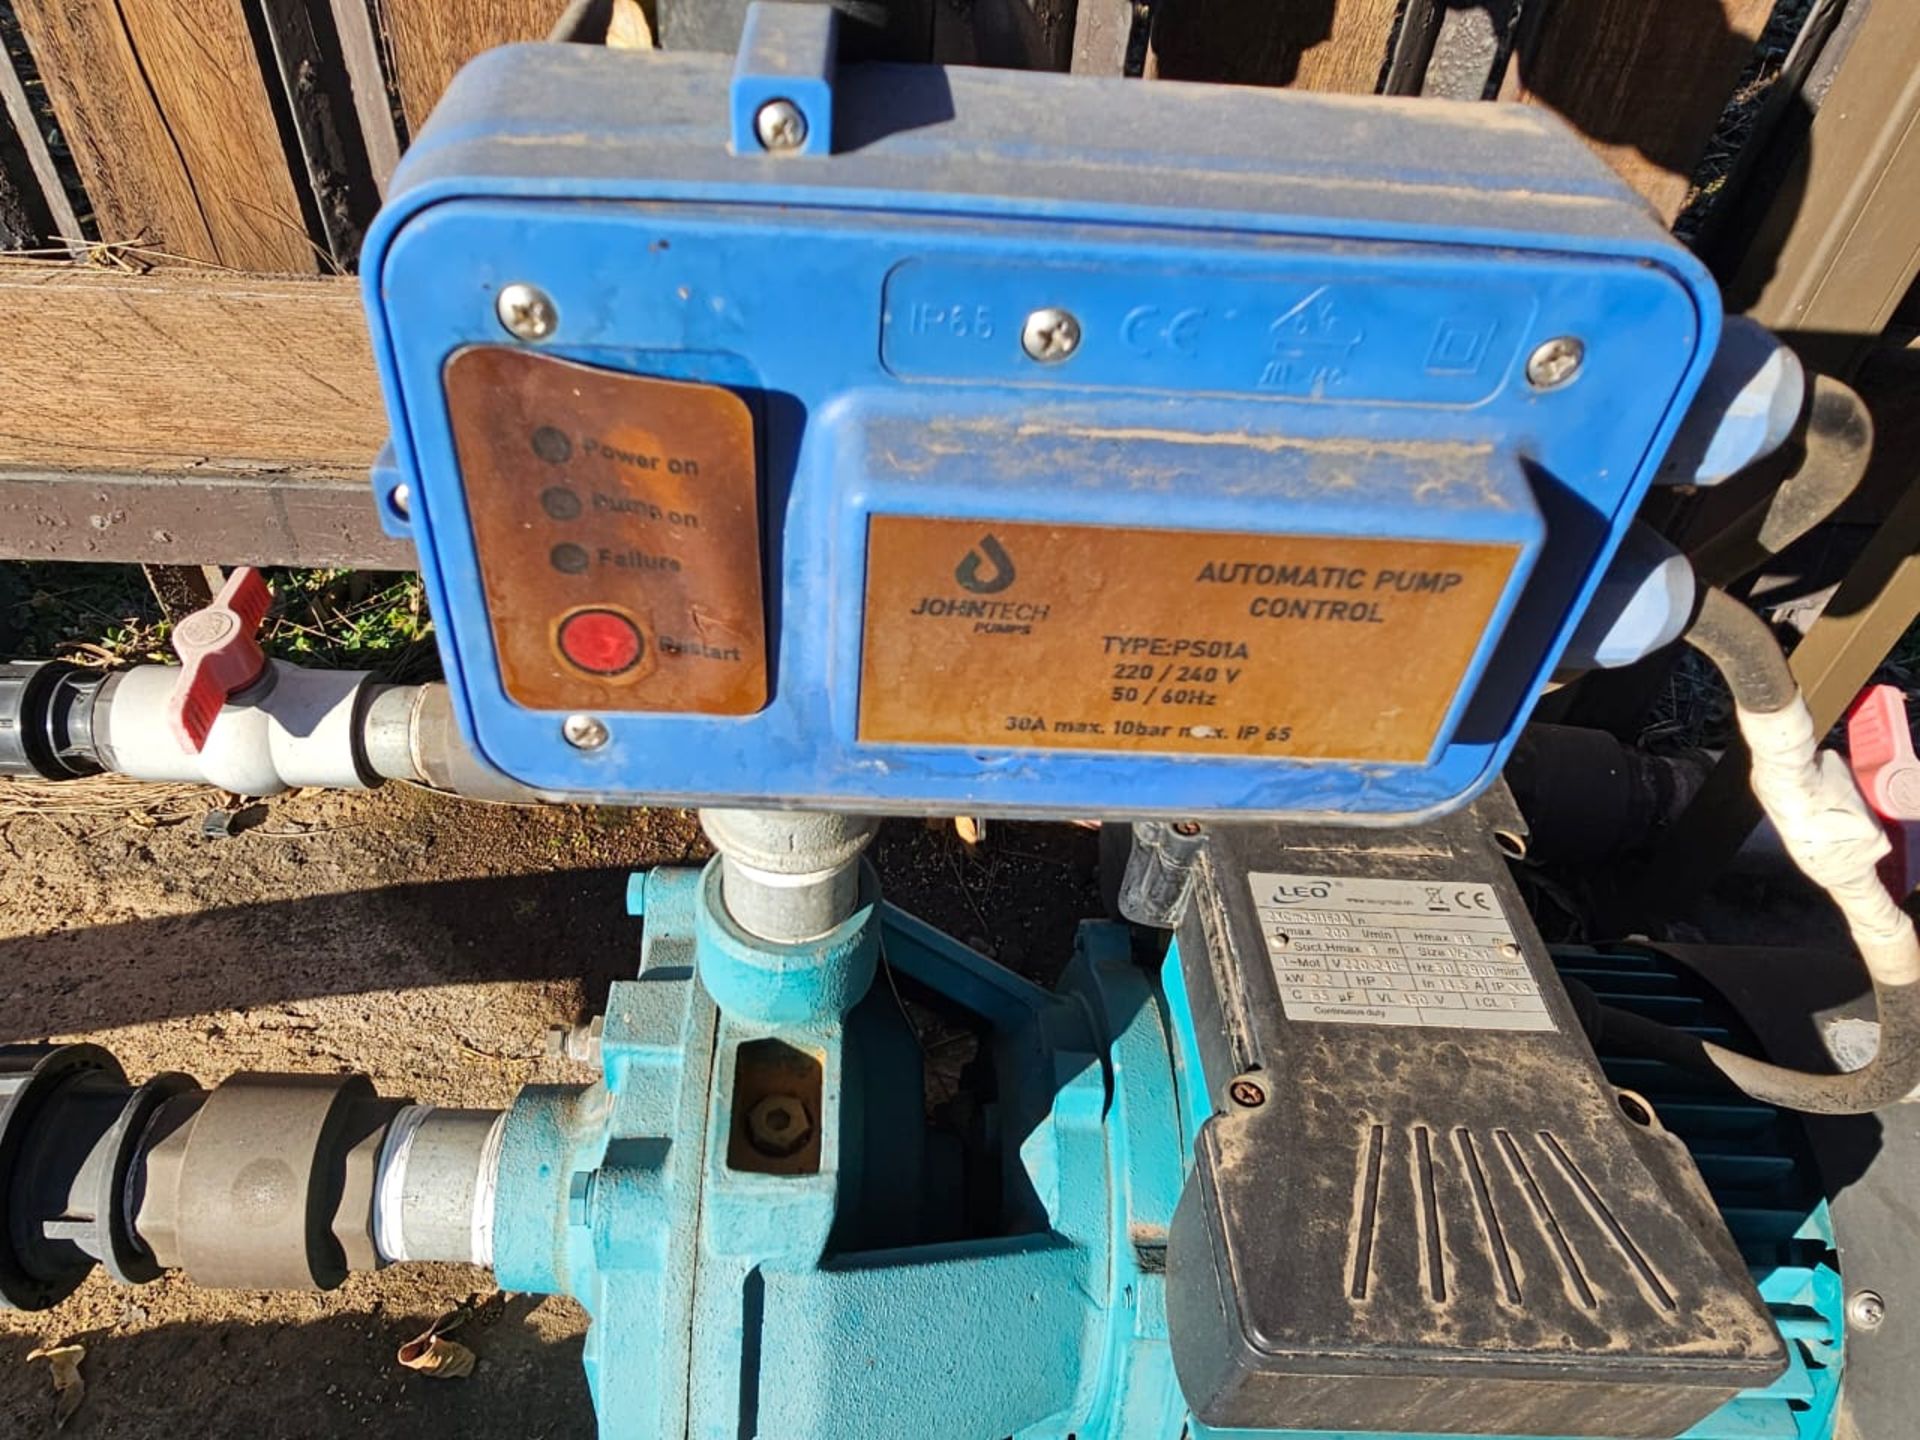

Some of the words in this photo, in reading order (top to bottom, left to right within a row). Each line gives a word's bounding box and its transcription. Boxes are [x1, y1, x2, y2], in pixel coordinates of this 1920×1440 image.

[582, 438, 661, 471] Power
[667, 457, 699, 477] on
[668, 510, 699, 529] on
[597, 547, 682, 573] Failure
[1196, 561, 1367, 590] AUTOMATIC
[1373, 569, 1463, 594] PUMP
[911, 597, 1051, 622] JOHNTECH
[1249, 597, 1384, 623] CONTROL
[973, 621, 1033, 636] PUMPS
[1113, 662, 1153, 681] 220
[1158, 664, 1174, 684] /
[1176, 666, 1218, 684] 240
[1225, 668, 1242, 685] V
[1111, 686, 1138, 703] 50
[1142, 687, 1158, 706] /
[1161, 688, 1218, 707] 60Hz
[1005, 716, 1046, 732] 30A
[1054, 720, 1105, 735] max.
[1113, 719, 1172, 738] 10bar
[1178, 725, 1229, 740] mx.
[1236, 725, 1260, 740] IP
[1265, 726, 1293, 743] 65
[1275, 883, 1330, 900] LEO
[1413, 932, 1449, 942] Hmax
[1418, 946, 1446, 957] Size
[1284, 973, 1305, 984] kW
[1355, 975, 1376, 985] HP
[1314, 1006, 1365, 1017] Continuous
[1366, 1008, 1387, 1019] duty
